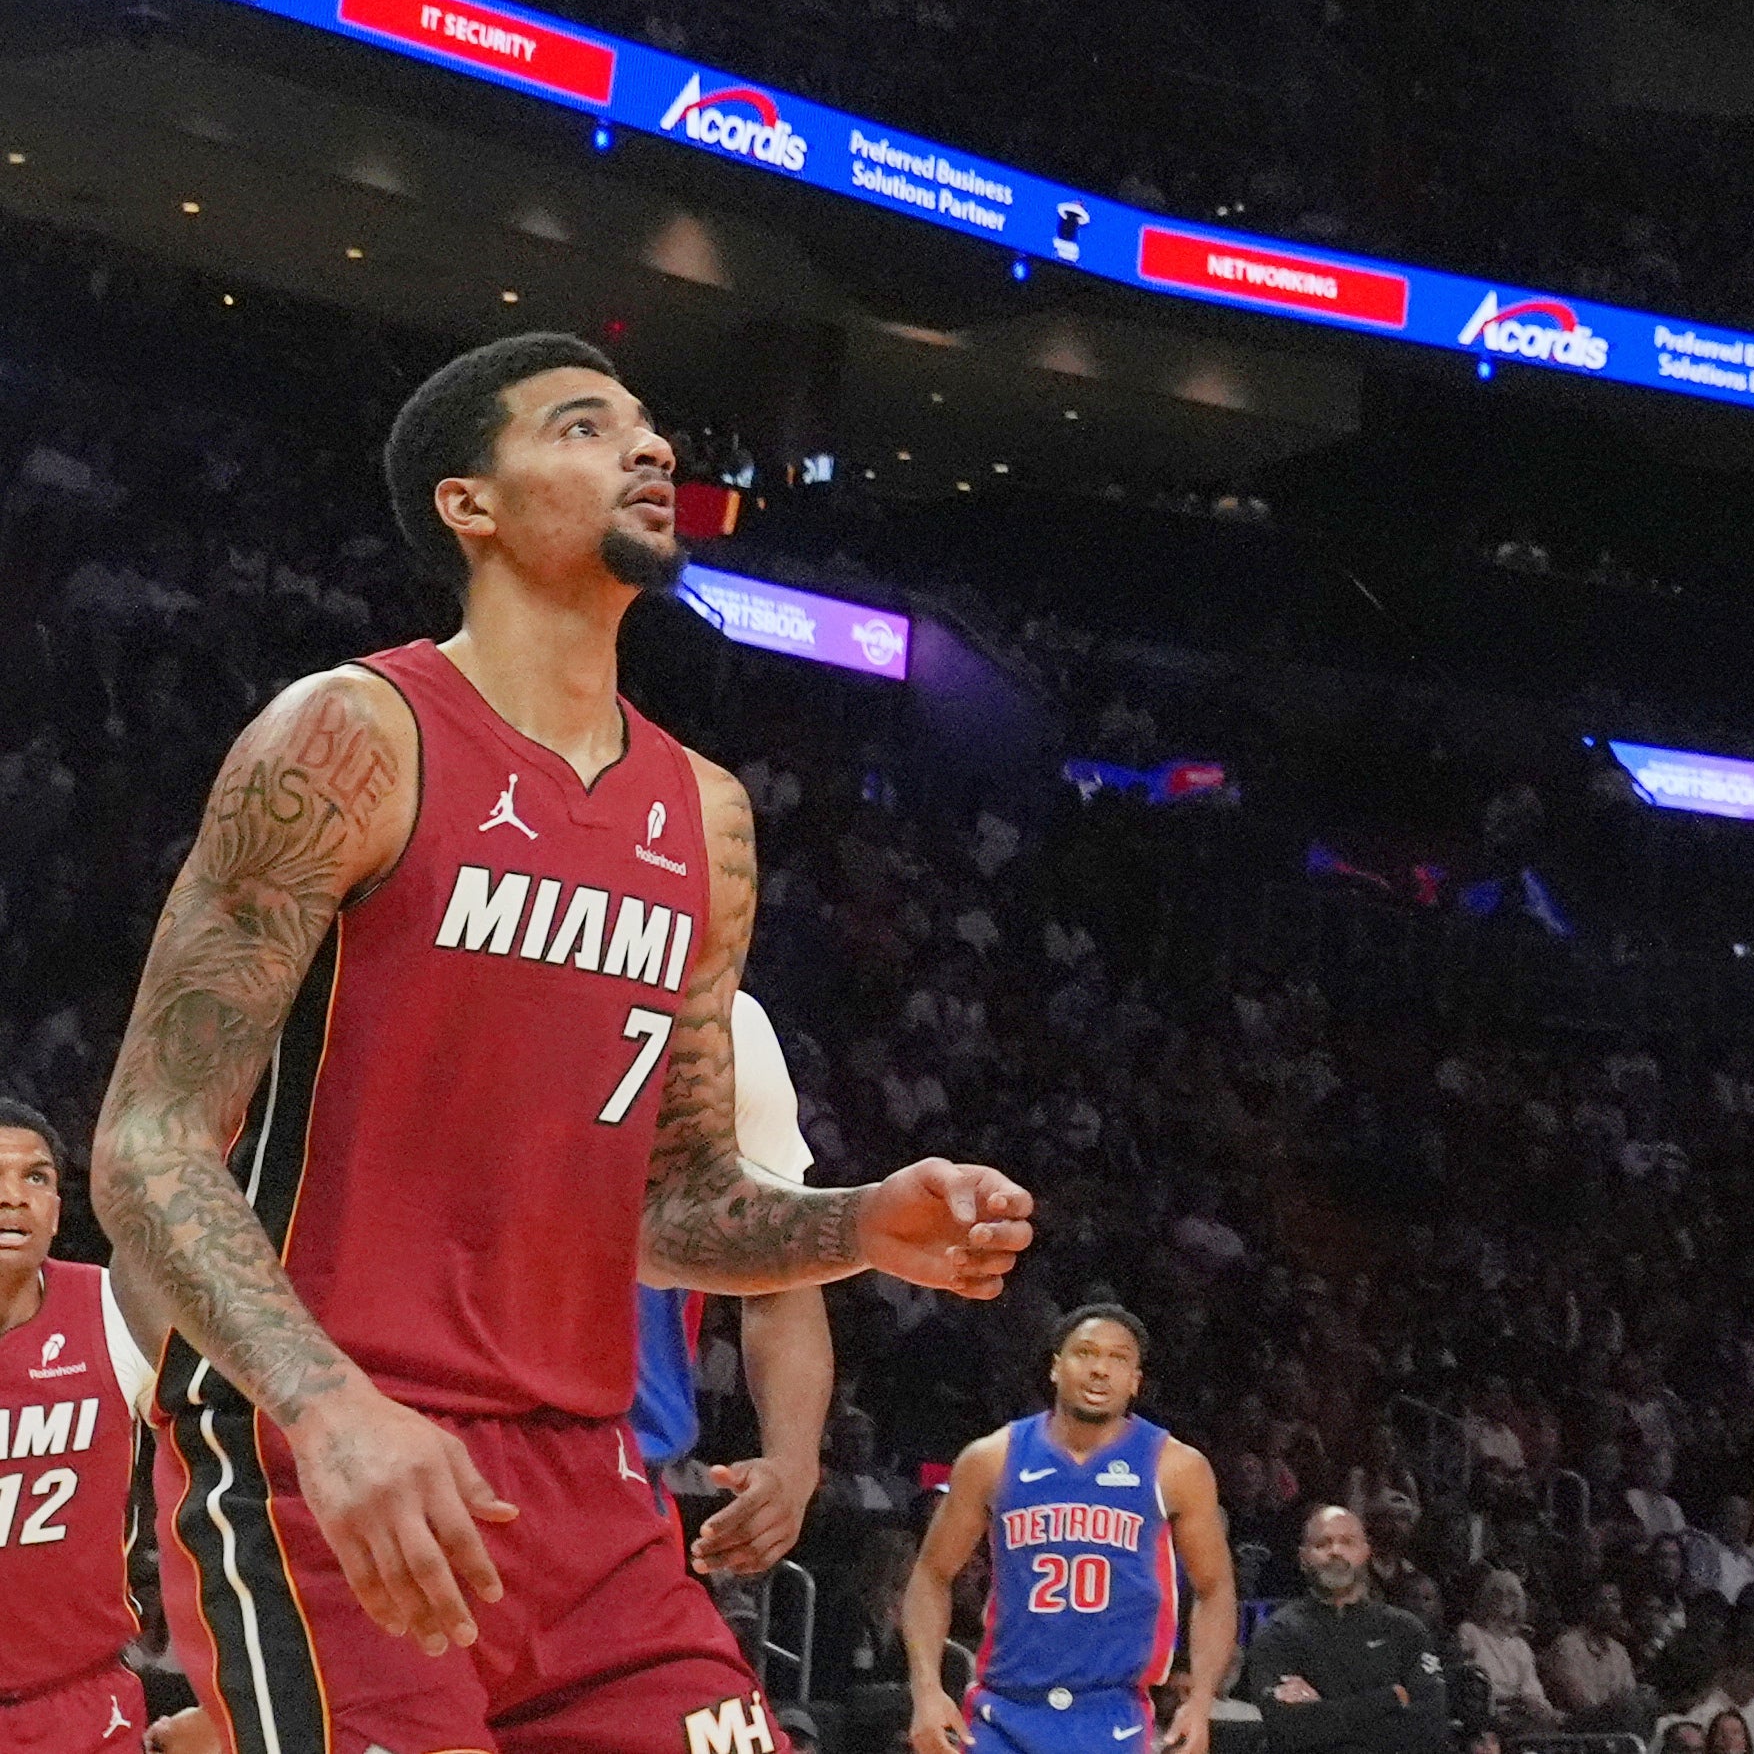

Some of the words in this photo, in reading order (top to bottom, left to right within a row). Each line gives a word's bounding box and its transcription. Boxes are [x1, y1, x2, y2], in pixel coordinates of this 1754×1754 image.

[419, 4, 442, 32] IT
[443, 12, 537, 62] SECURITY
[660, 71, 808, 173] Acordis
[849, 129, 935, 179] Preferred
[935, 162, 1013, 206] Business
[851, 159, 935, 209] Solutions
[937, 186, 1006, 233] Partner
[1206, 252, 1338, 299] NETWORKING
[1458, 289, 1609, 372] Acordis
[634, 844, 688, 878] Robinhood
[435, 865, 694, 994] MIAMI
[597, 1006, 674, 1126] 7
[29, 1362, 86, 1379] Robinhood
[0, 1467, 78, 1547] 12
[1003, 1502, 1145, 1553] DETROIT
[1028, 1553, 1111, 1614] 20
